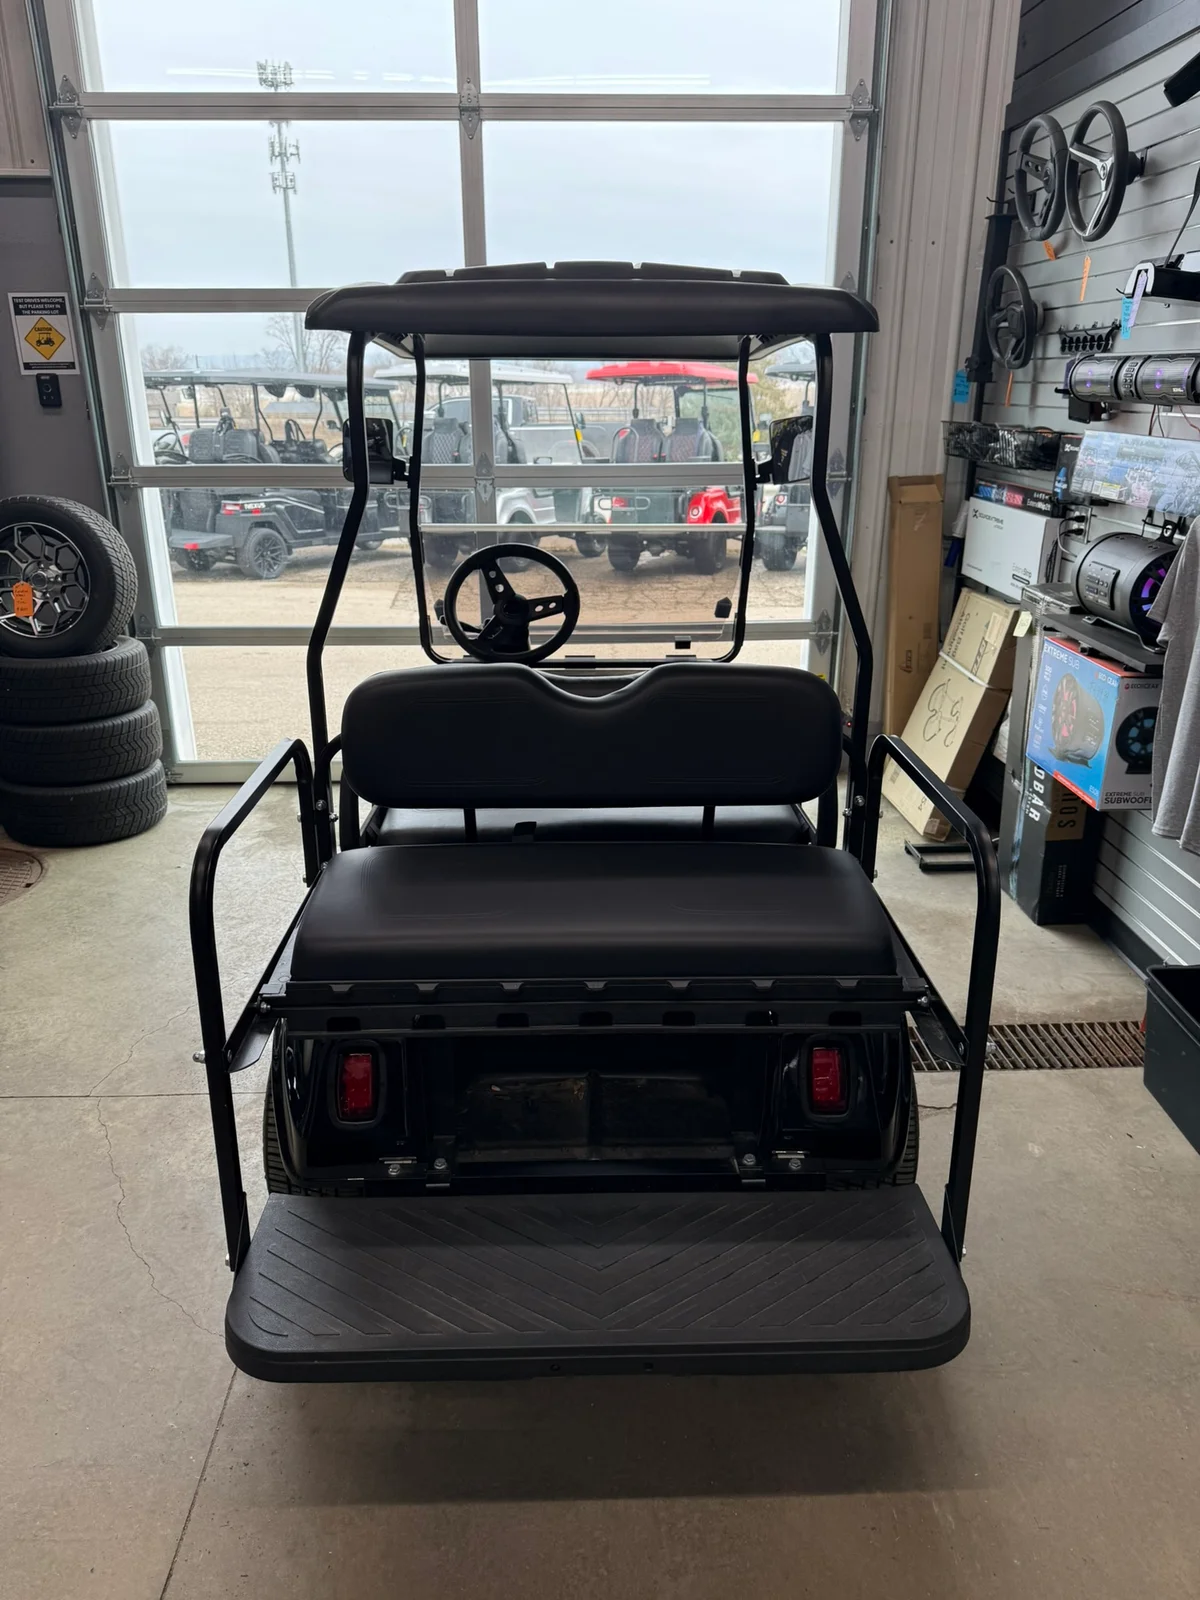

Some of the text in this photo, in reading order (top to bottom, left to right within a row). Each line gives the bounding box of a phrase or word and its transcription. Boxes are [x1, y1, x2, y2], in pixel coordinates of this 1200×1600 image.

[1043, 643, 1068, 664] EXTREME
[1028, 766, 1046, 822] DBAR
[1104, 796, 1153, 805] SUBWOOFE
